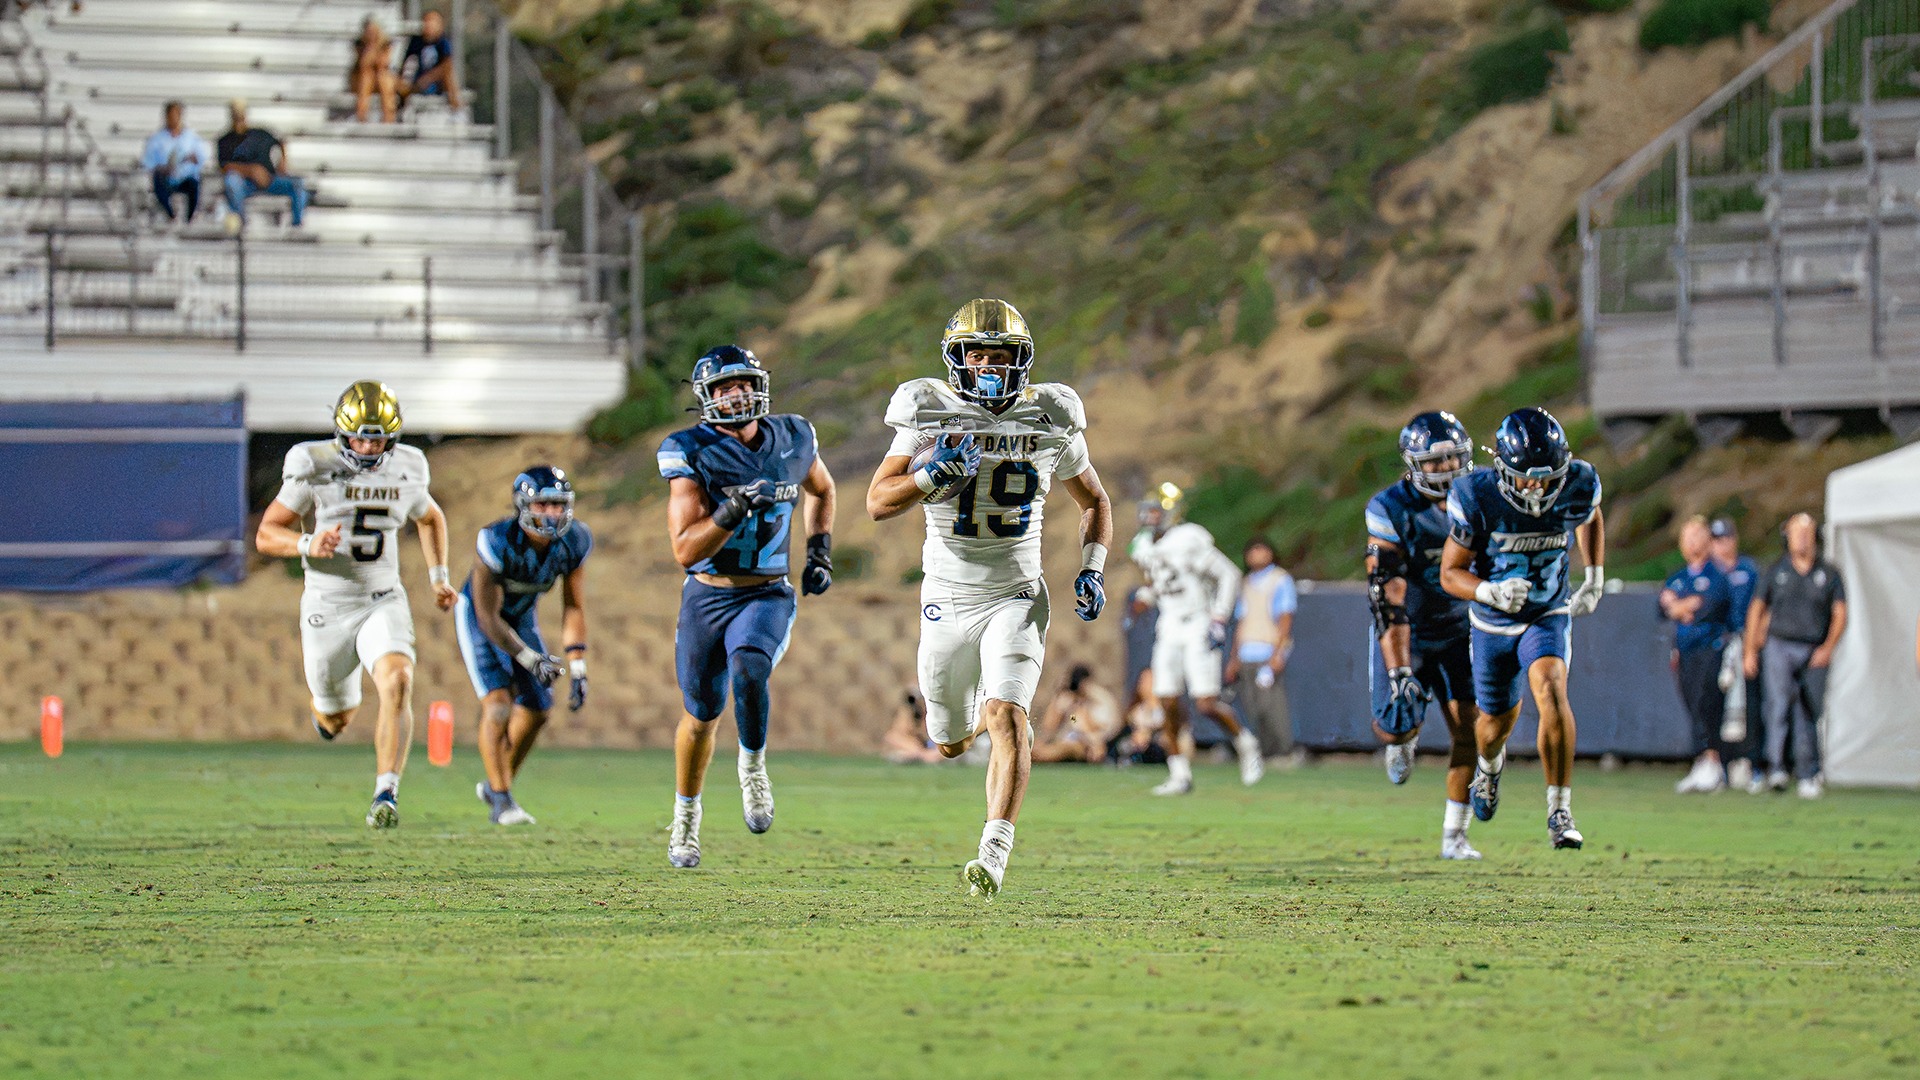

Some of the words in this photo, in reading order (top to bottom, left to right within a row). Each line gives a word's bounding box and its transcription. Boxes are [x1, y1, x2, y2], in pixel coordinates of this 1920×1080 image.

[984, 434, 1038, 453] DAVIS
[363, 486, 400, 500] DAVIS
[952, 459, 1040, 538] 19
[350, 505, 389, 562] 5
[723, 501, 793, 569] 42
